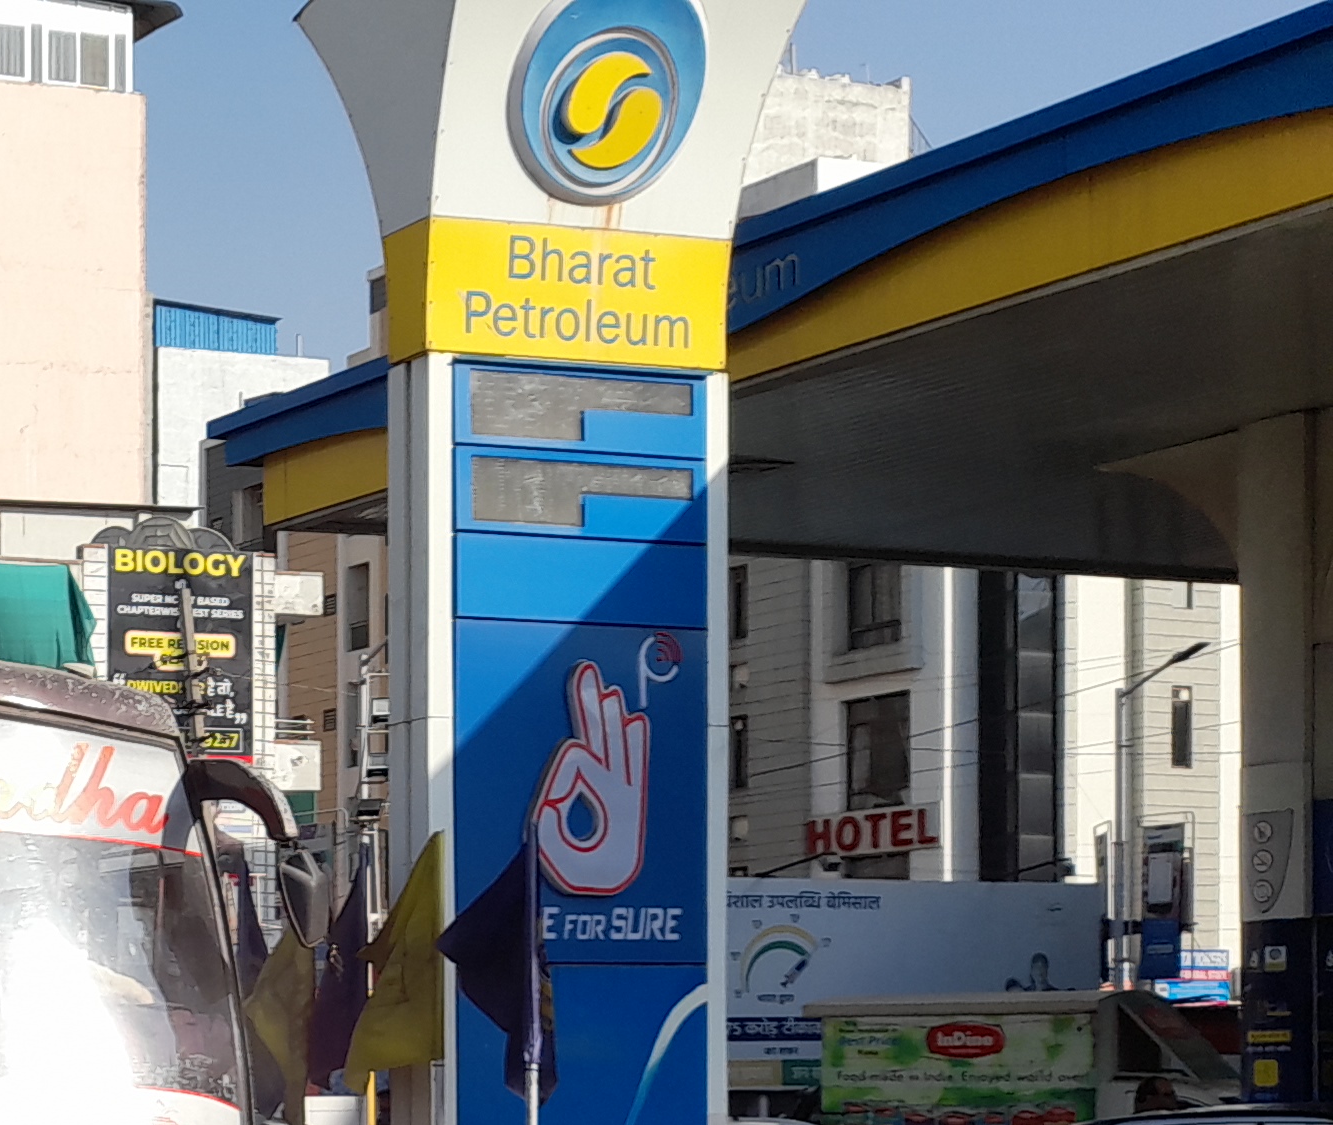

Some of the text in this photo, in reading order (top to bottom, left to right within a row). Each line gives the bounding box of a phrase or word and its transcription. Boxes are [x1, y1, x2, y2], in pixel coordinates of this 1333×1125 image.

[507, 235, 657, 292] Bharat
[464, 290, 691, 351] Petroleum
[114, 548, 247, 577] BIOLOGY
[130, 636, 230, 651] FREE RESION
[806, 808, 939, 855] HOTEL
[563, 913, 605, 940] FOR
[610, 907, 682, 941] SURE
